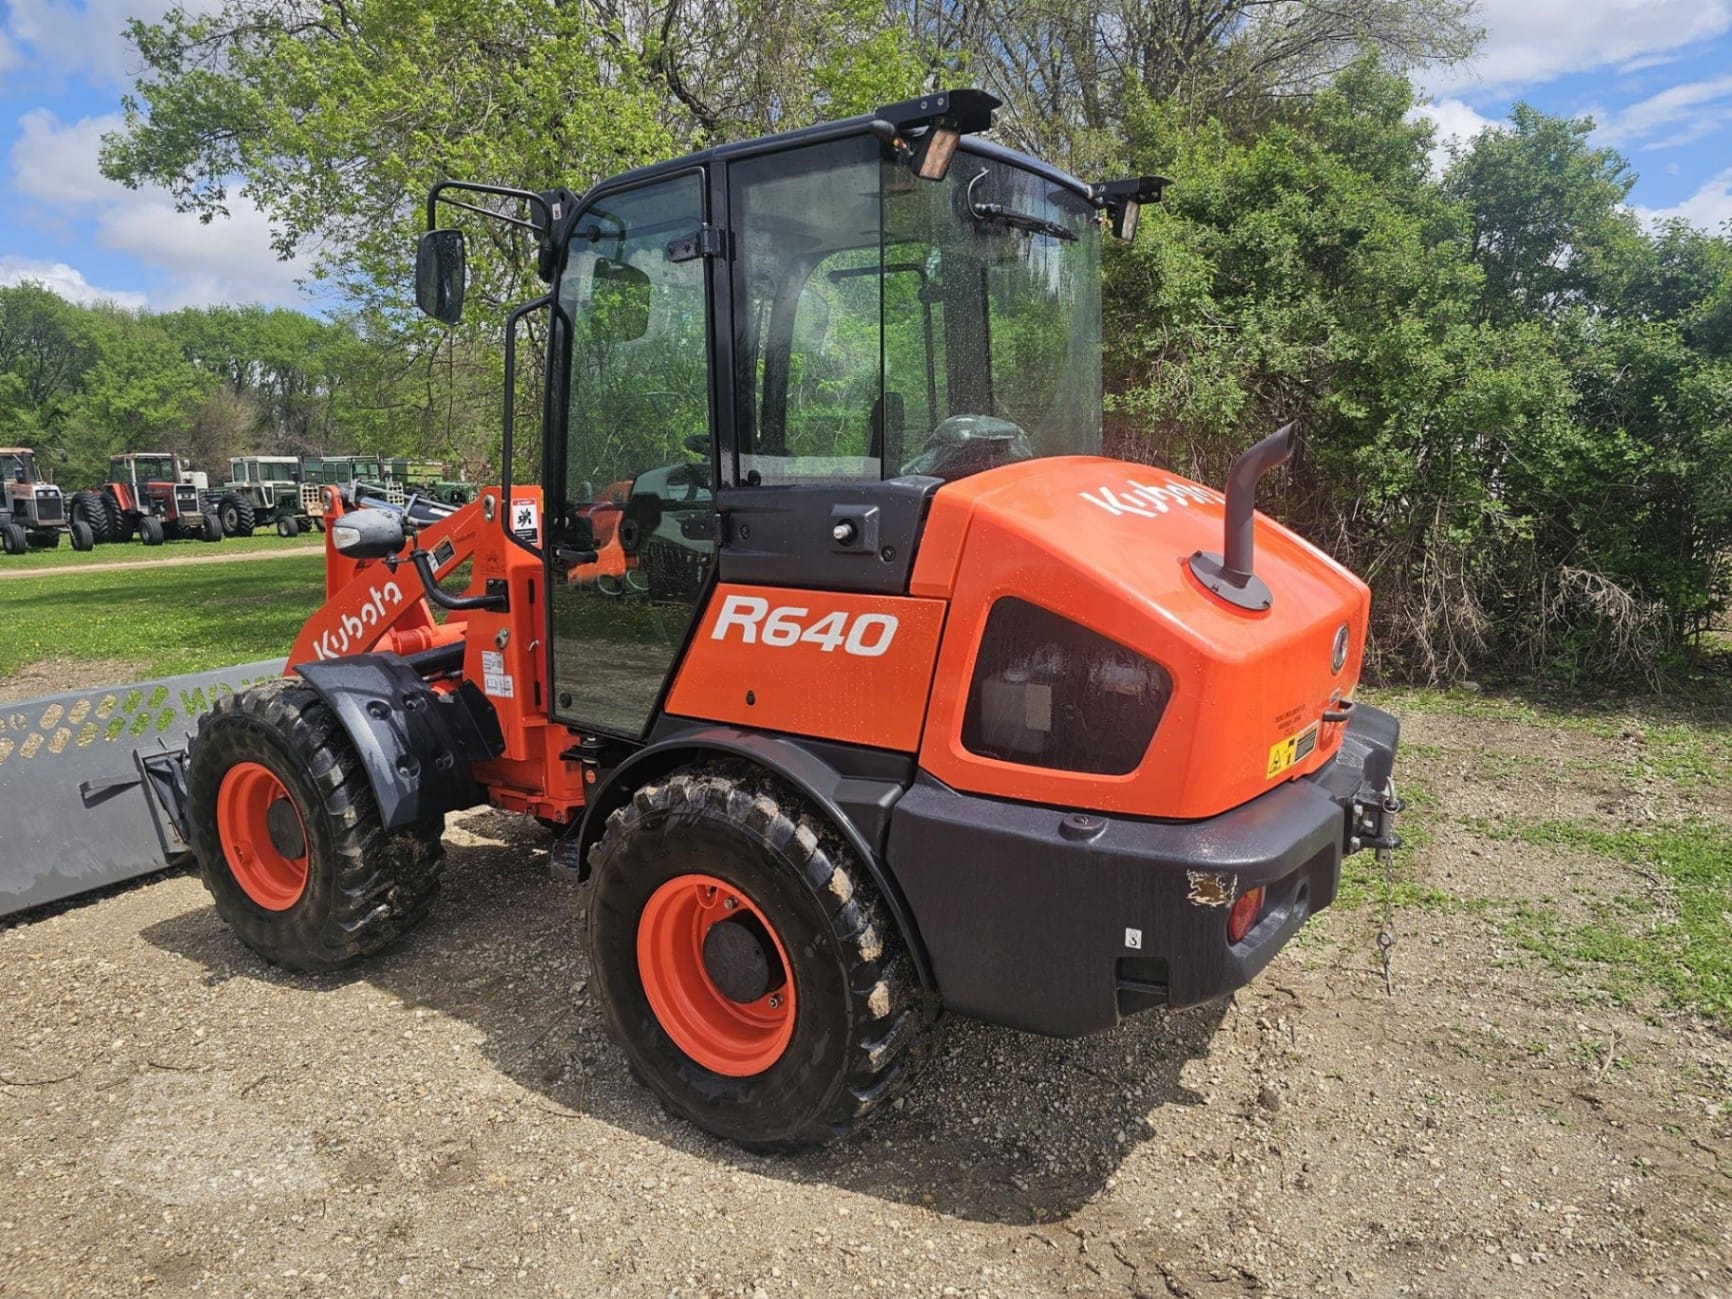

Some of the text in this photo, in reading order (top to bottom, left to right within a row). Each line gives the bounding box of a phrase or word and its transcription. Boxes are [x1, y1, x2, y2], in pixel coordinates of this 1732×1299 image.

[1079, 478, 1225, 518] Kubota
[313, 582, 403, 660] Kubota
[711, 595, 899, 656] R640
